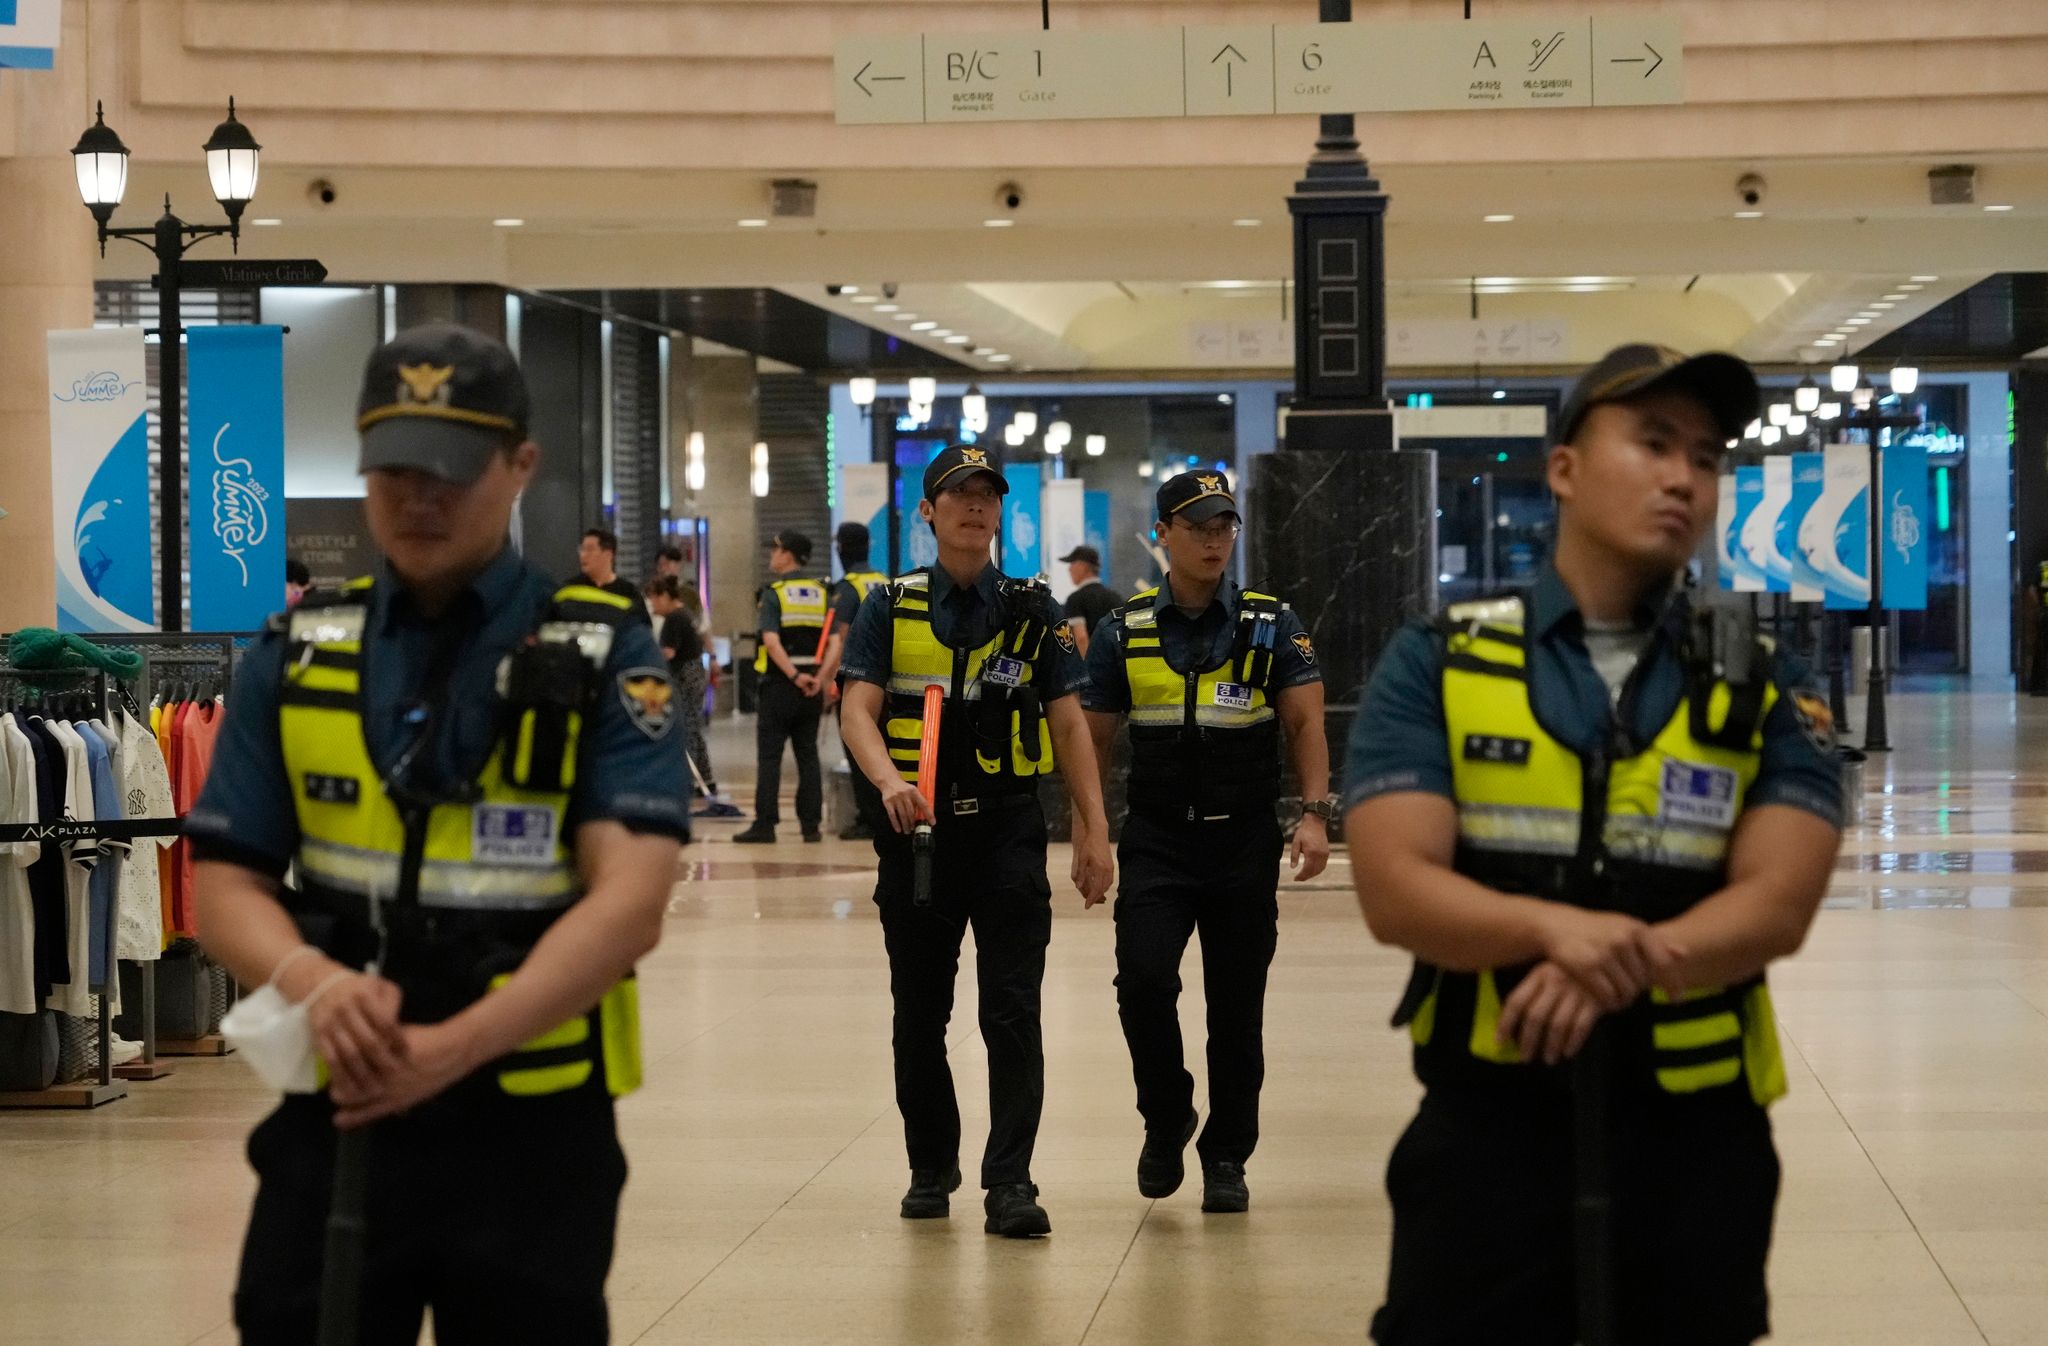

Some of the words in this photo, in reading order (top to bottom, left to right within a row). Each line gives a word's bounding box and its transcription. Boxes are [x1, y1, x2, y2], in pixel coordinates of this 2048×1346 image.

[947, 50, 1000, 83] B/C
[1033, 50, 1041, 77] 1
[1302, 43, 1322, 71] 6
[1473, 41, 1496, 68] A
[276, 265, 316, 281] Circle
[246, 477, 269, 501] 2023
[988, 672, 1017, 685] POLICE
[1218, 698, 1249, 707] POLICE
[22, 825, 56, 839] AK
[58, 826, 97, 835] PLAZA
